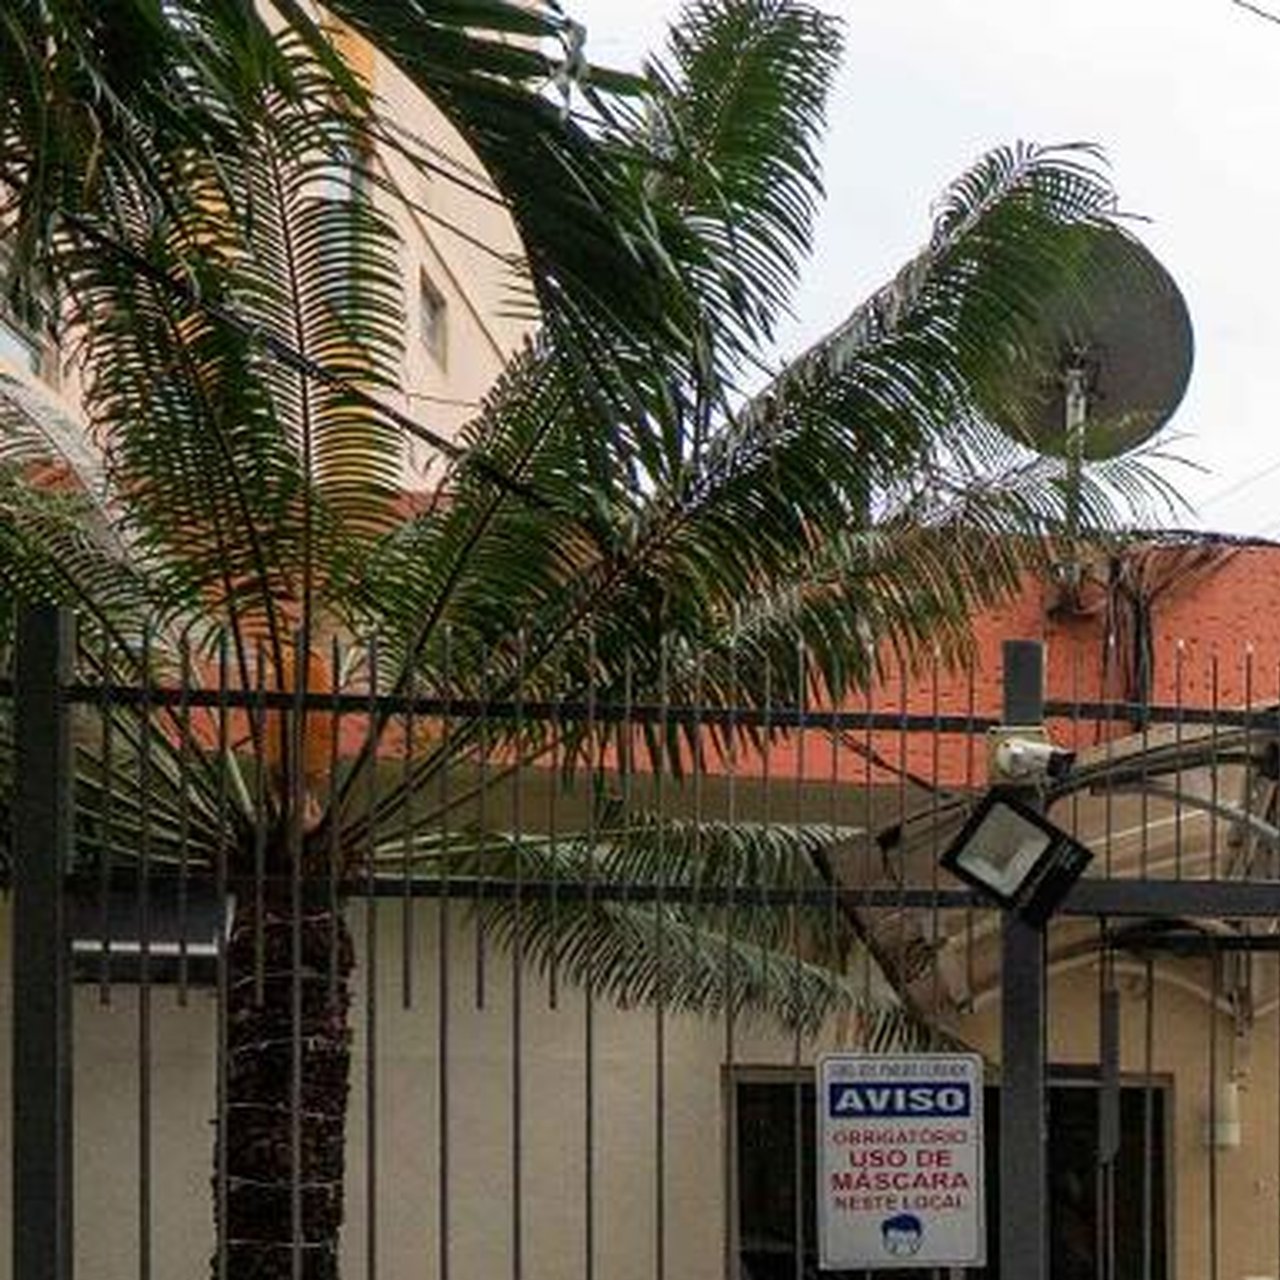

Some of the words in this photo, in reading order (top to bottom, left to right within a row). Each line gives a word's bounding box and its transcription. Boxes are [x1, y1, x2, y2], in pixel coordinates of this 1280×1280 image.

[834, 1087, 966, 1112] AVISO
[832, 1127, 967, 1145] OBRIGATÓRIO
[849, 1150, 908, 1168] USO
[916, 1150, 953, 1168] DE
[831, 1168, 970, 1191] MÁSCARA
[835, 1195, 896, 1210] NESTE
